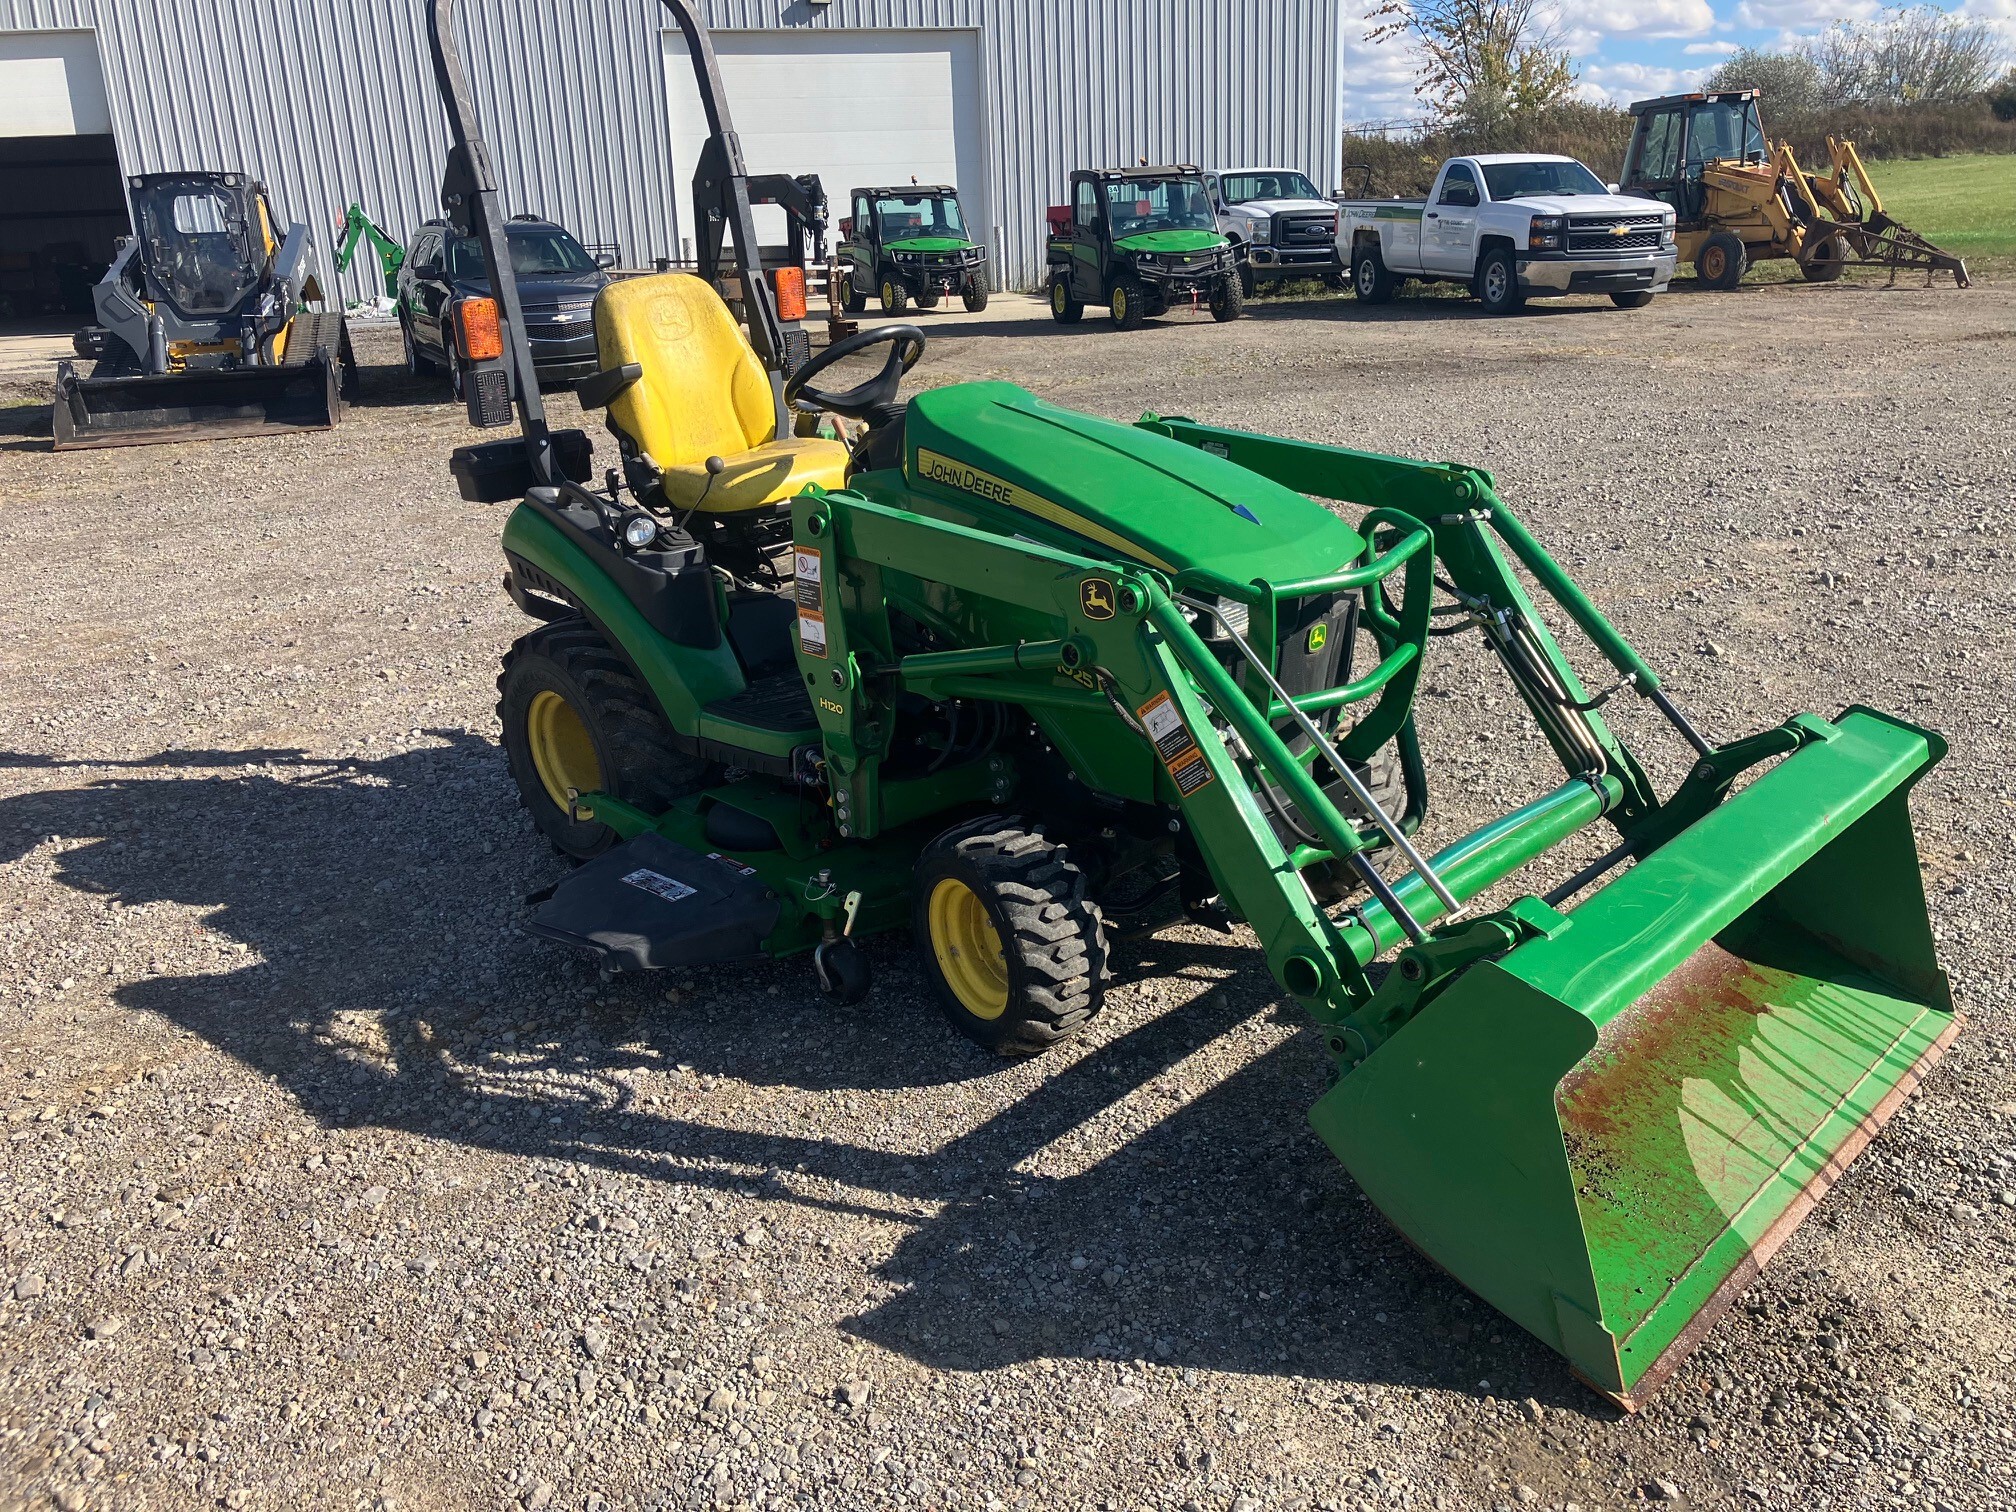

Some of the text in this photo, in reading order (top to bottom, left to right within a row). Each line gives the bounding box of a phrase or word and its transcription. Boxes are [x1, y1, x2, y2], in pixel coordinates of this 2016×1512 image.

[926, 460, 1013, 504] JOHN DEERE
[820, 697, 843, 715] H120
[1146, 694, 1166, 711] WARNING
[1177, 752, 1199, 767] WARNING
